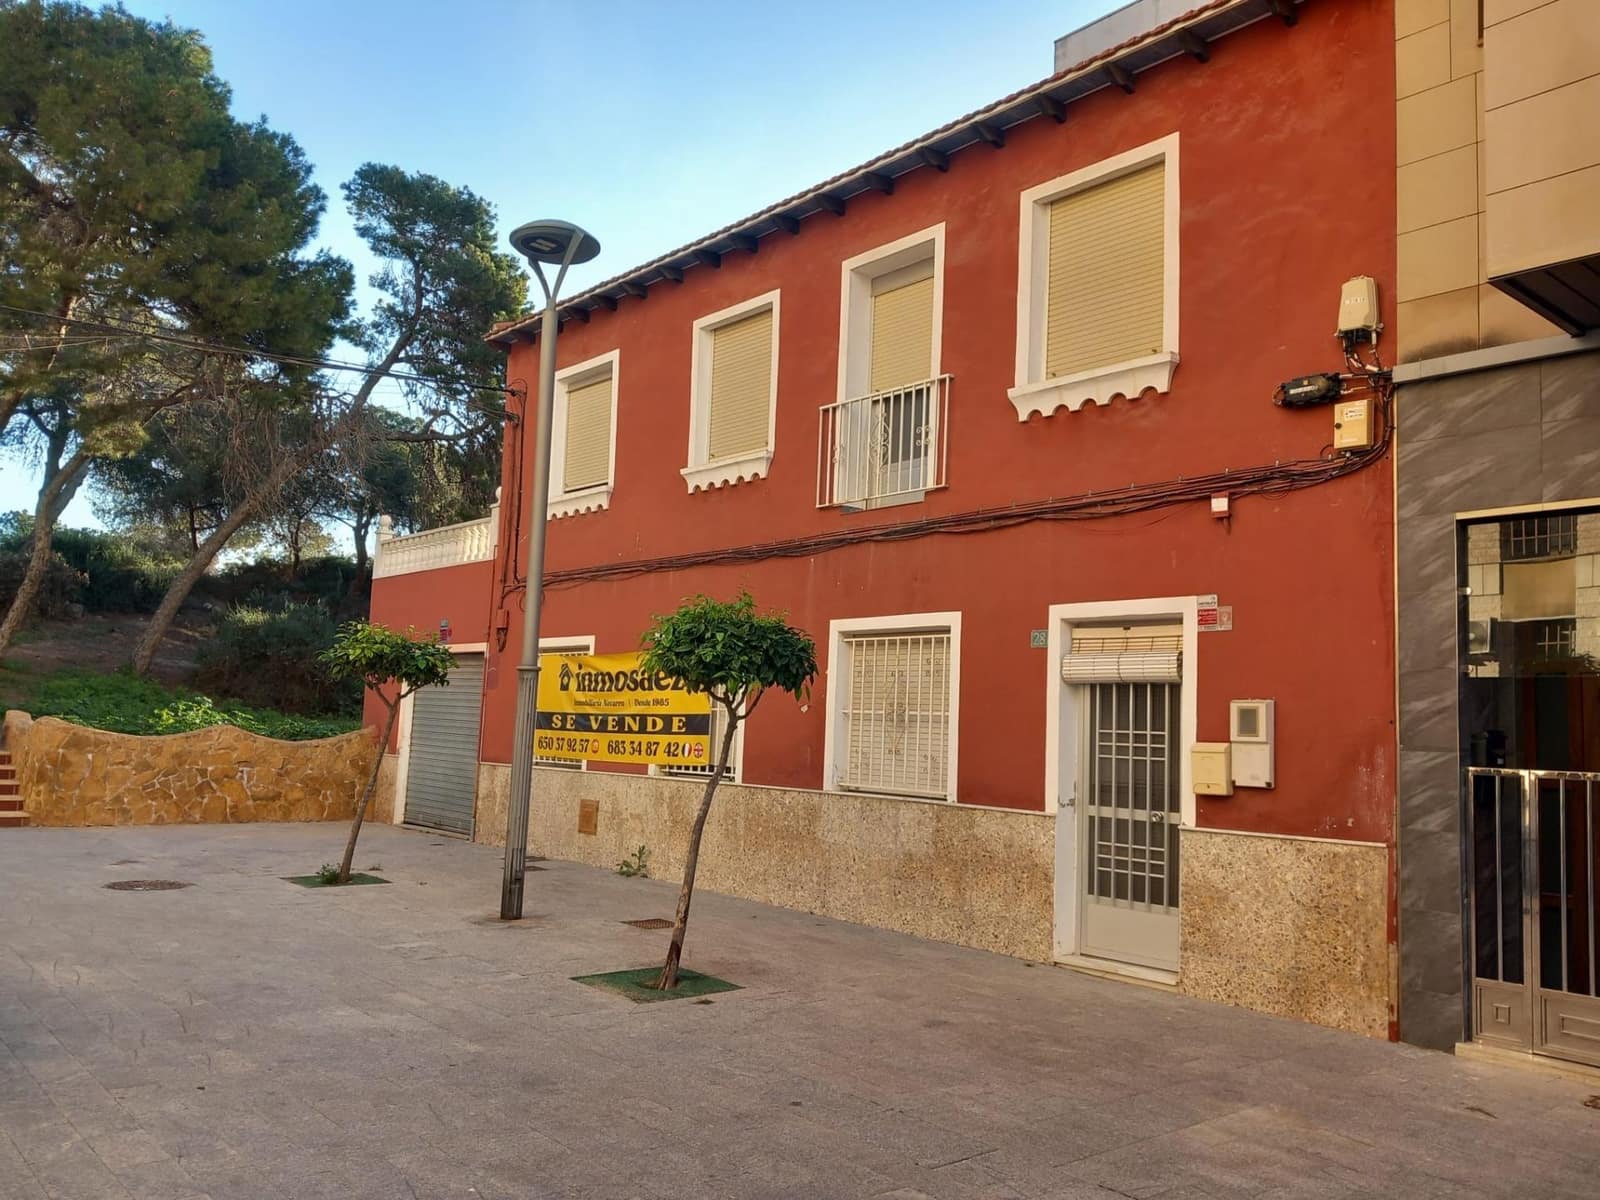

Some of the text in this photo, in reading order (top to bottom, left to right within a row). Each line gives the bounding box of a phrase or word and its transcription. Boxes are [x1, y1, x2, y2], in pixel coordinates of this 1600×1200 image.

[652, 697, 669, 707] 1985
[551, 714, 686, 733] SE VENDE
[537, 735, 590, 753] 650 37 92 57
[607, 739, 679, 758] 683 34 87 42
